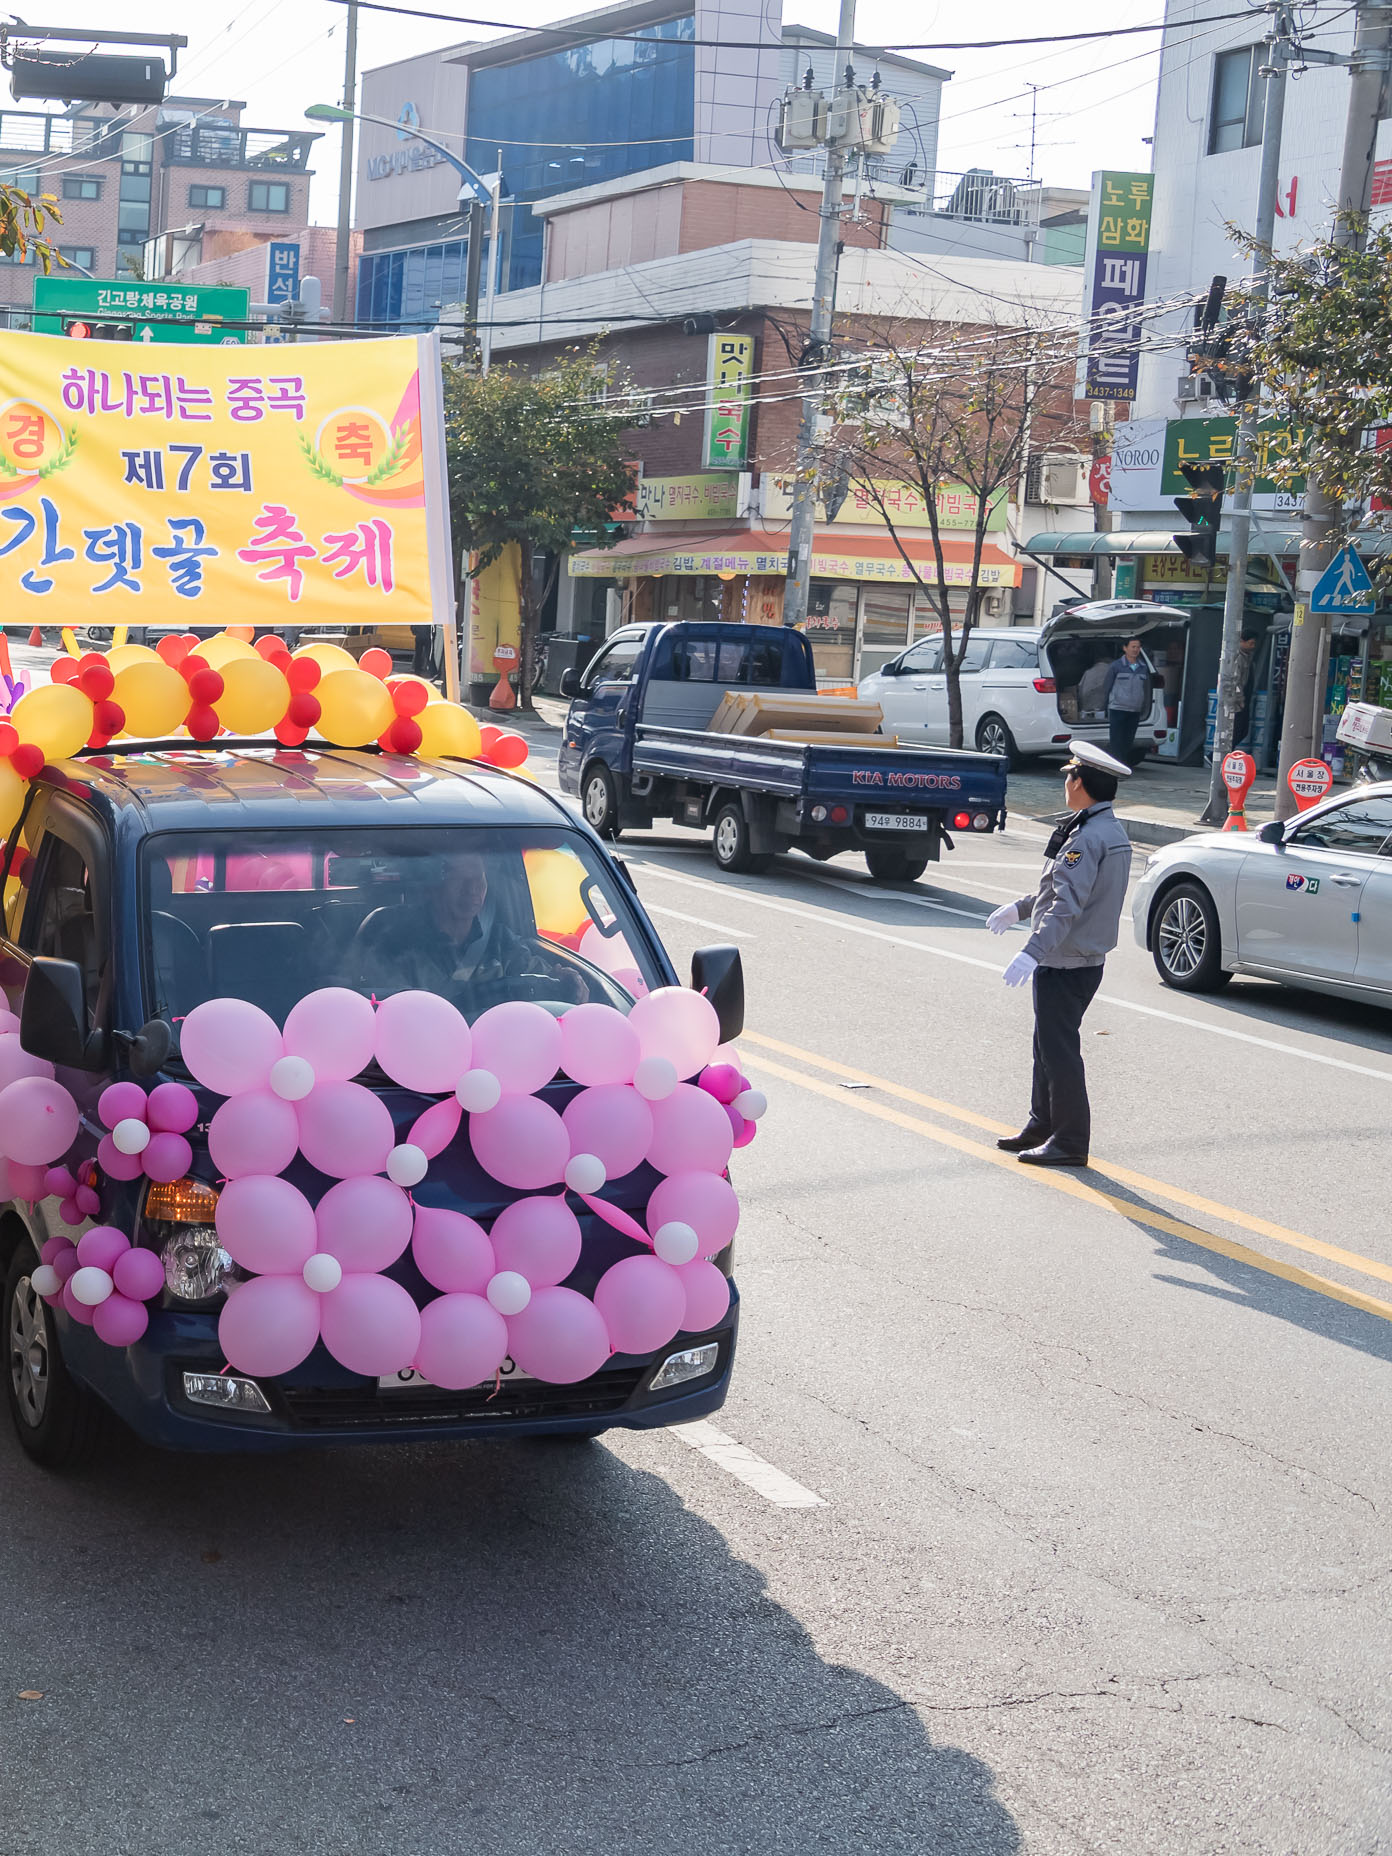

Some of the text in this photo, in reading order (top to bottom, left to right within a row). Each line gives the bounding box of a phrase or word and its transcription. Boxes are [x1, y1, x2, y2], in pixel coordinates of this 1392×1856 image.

[1103, 180, 1150, 211] 노루
[1100, 216, 1149, 247] 삼화
[271, 250, 297, 301] 반석
[97, 289, 198, 312] 긴고랑체육공원
[61, 367, 307, 422] 하나되는 중곡
[1088, 385, 1135, 400] 3437-1349
[7, 414, 46, 460] 경
[334, 421, 375, 467] 축
[121, 443, 254, 494] 제7회
[1115, 449, 1160, 467] NOROO
[237, 504, 395, 601] 축제
[852, 770, 962, 790] KIA MOTORS
[895, 816, 923, 829] 9884
